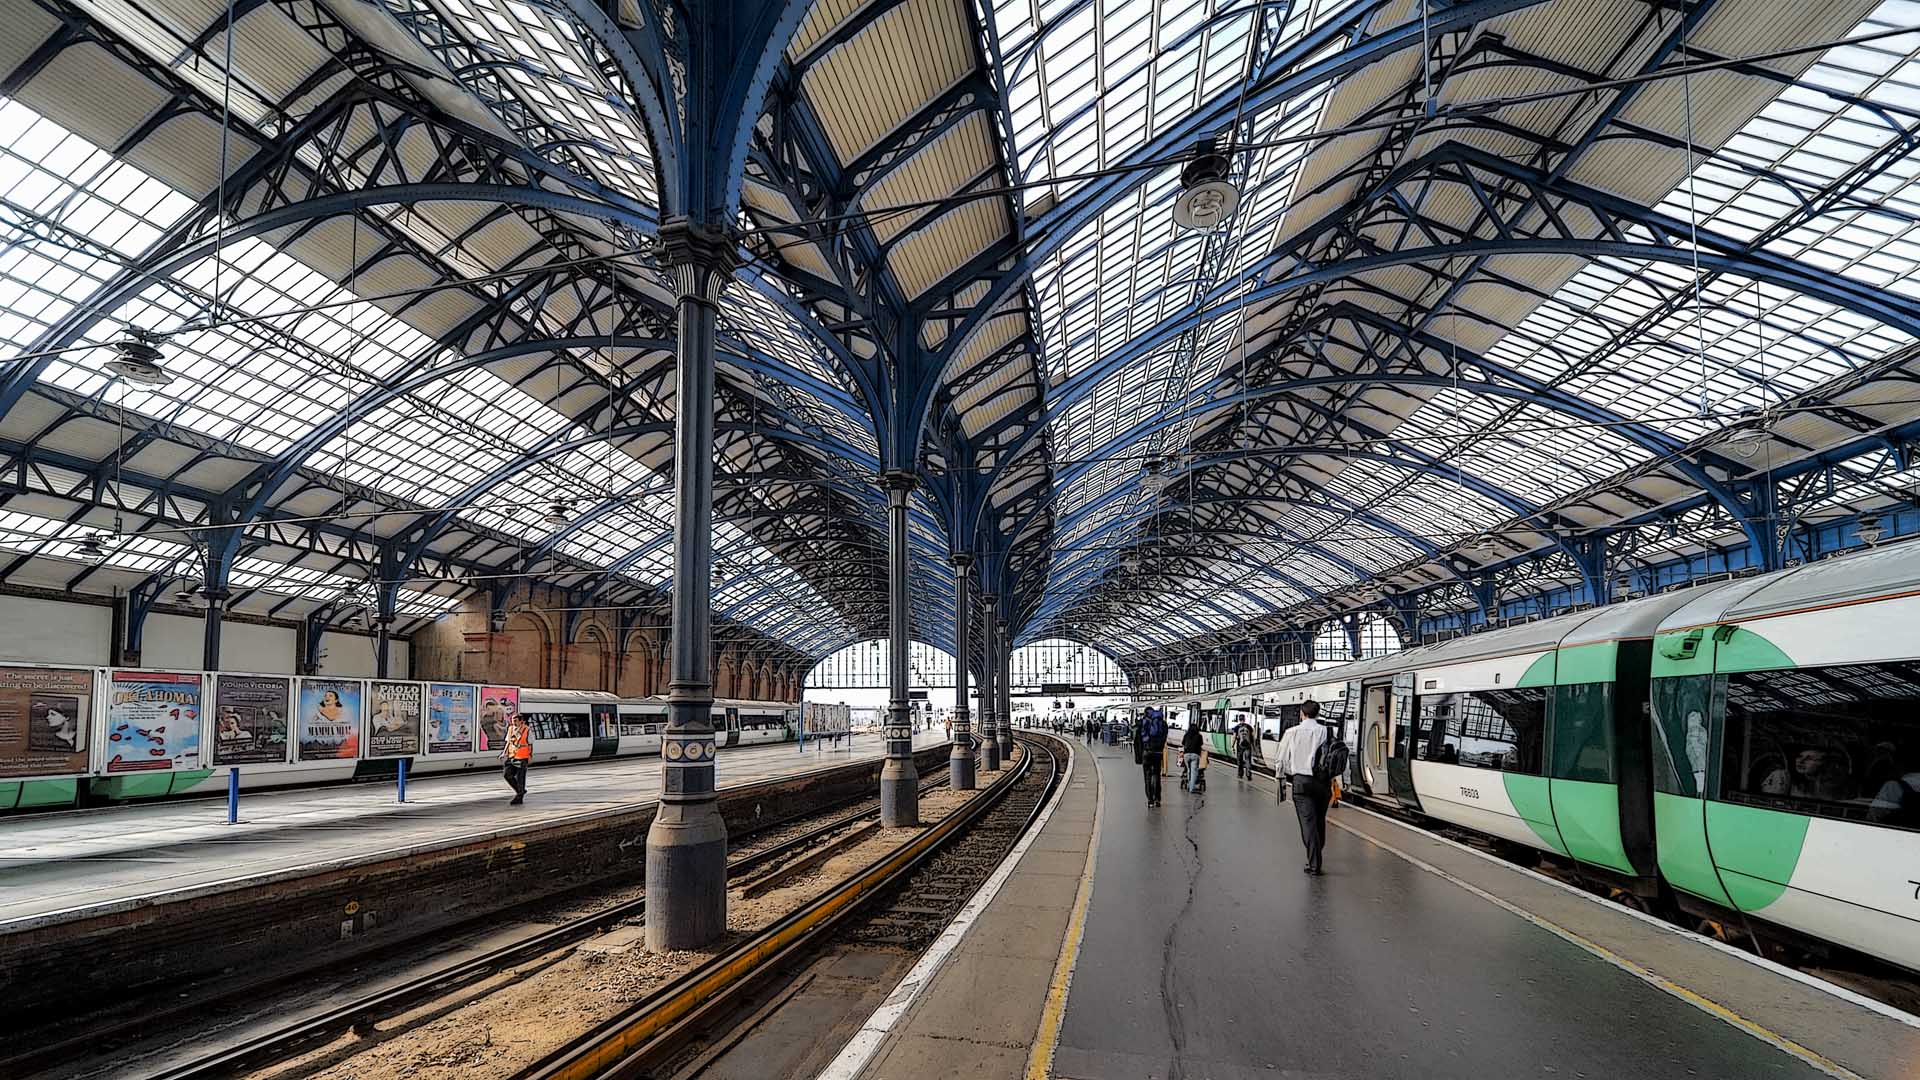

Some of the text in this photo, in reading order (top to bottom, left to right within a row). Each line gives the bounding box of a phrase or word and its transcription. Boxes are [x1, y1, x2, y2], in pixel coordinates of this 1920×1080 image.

[379, 685, 420, 694] PAOLO
[378, 692, 420, 701] NUTINI
[308, 726, 335, 736] MAMMA
